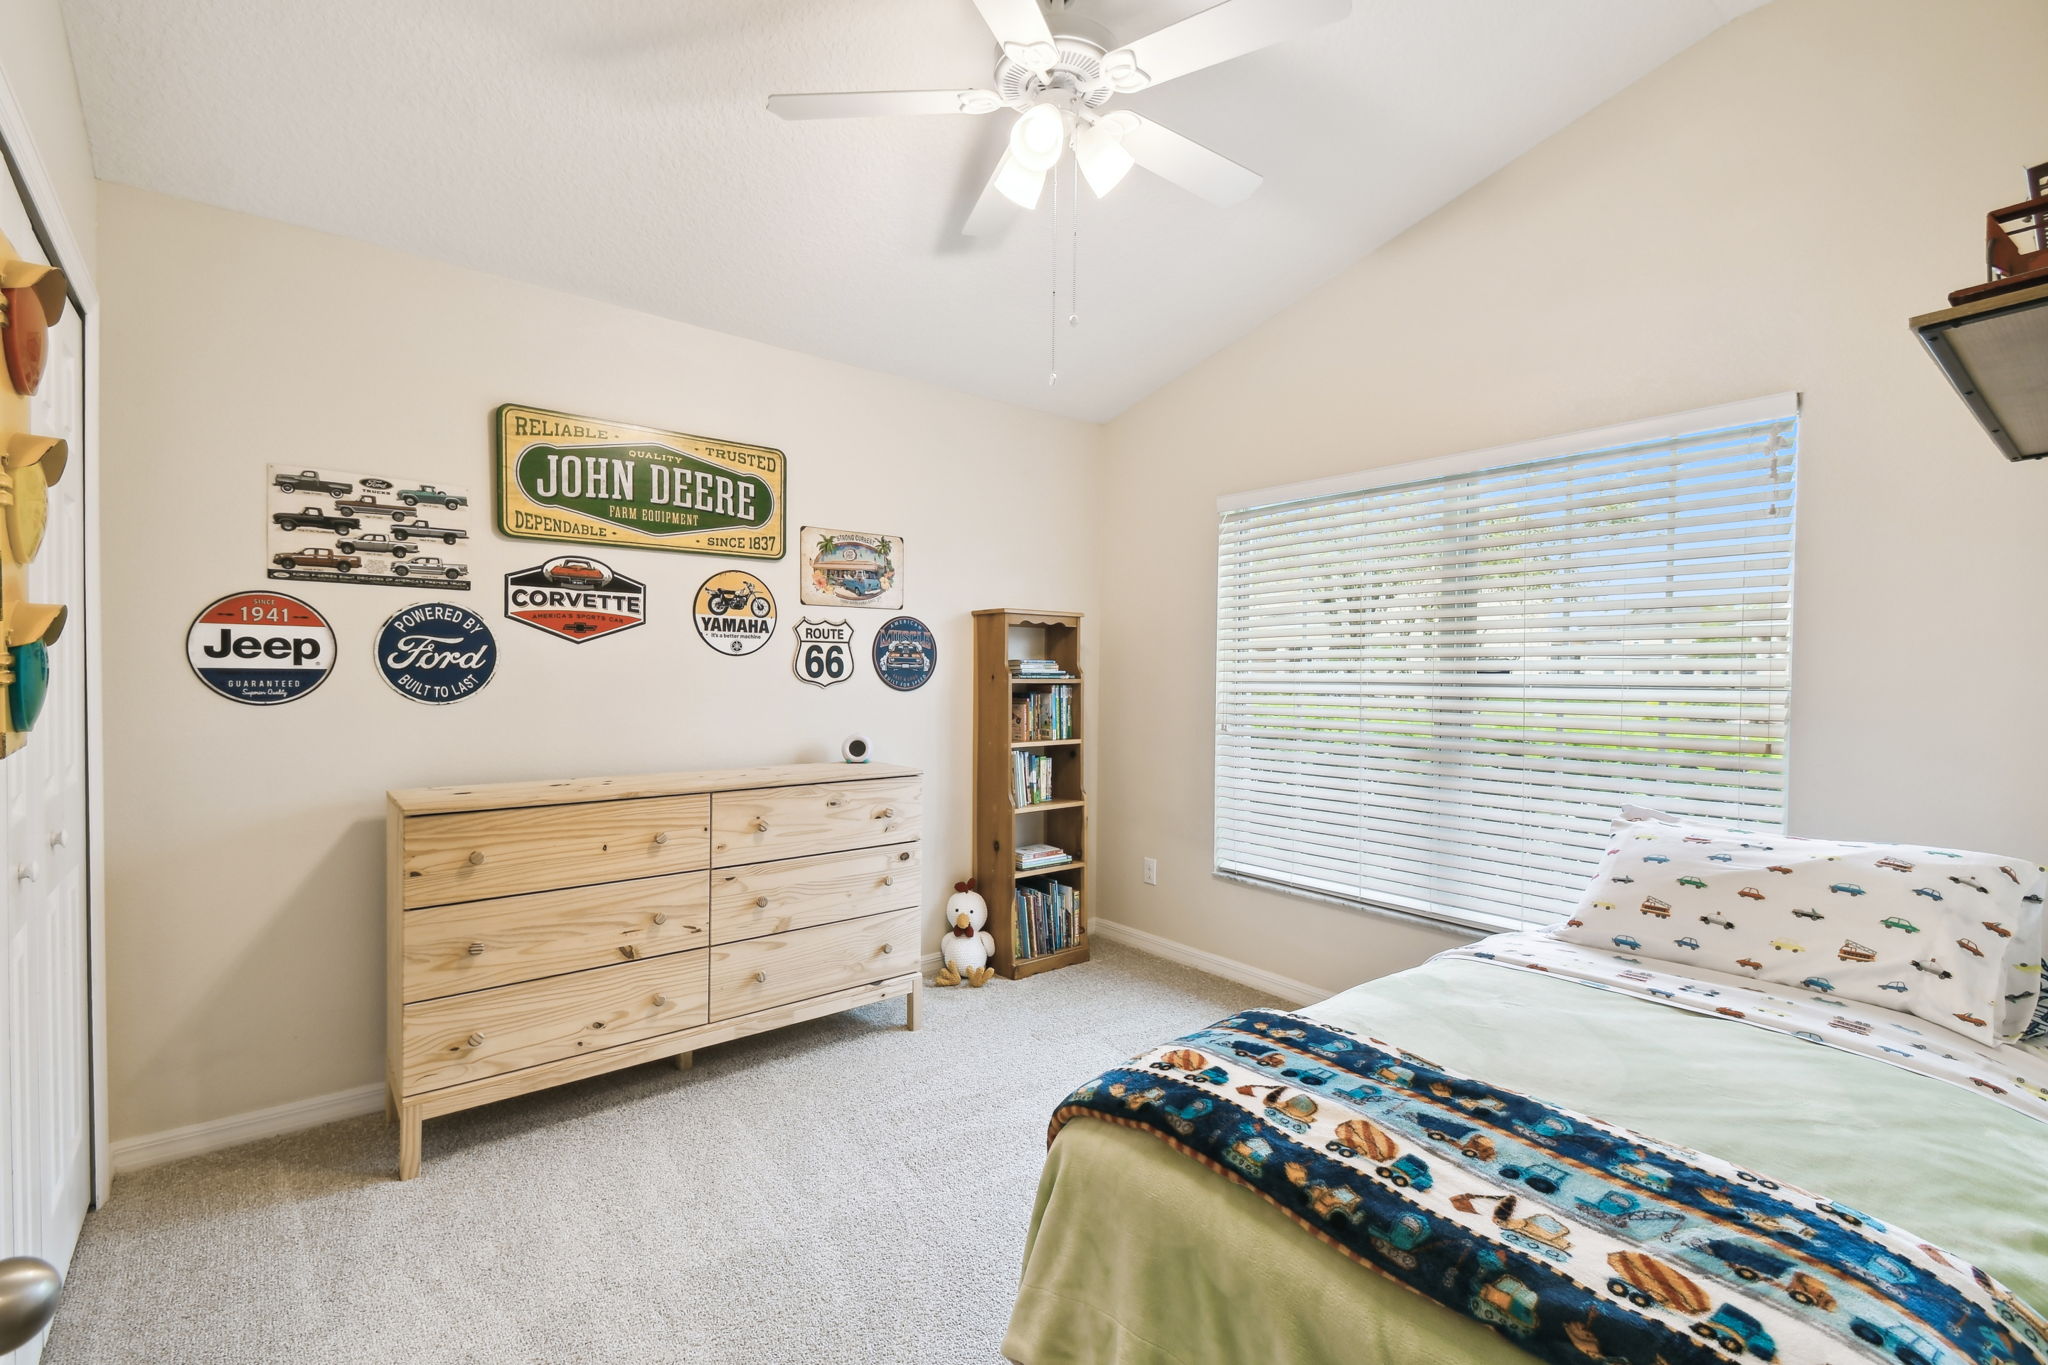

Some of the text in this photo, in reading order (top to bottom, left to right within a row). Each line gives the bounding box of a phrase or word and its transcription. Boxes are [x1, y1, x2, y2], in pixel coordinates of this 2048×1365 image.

[514, 416, 609, 439] RELIABLE
[629, 450, 683, 464] QUALITY
[705, 447, 776, 472] TRUSTED
[536, 455, 755, 521] JOHN DEERE
[514, 510, 607, 537] DEPENDABLE
[609, 505, 699, 526] FARM EQUIPMENT
[707, 536, 776, 551] SINCE 1837
[253, 598, 276, 606] SINCE
[511, 588, 641, 614] CORVETTE
[240, 606, 289, 622] 1941
[393, 606, 484, 634] POWERED BY
[701, 616, 770, 634] YAMAHA
[890, 619, 922, 630] AMERICAN
[805, 627, 845, 640] ROUTE
[203, 628, 321, 666] Jeep
[387, 635, 489, 670] Ford
[805, 644, 845, 679] 66
[227, 680, 301, 688] GUARANTEED
[267, 688, 288, 698] Quality
[397, 673, 479, 698] BUILT TO LAST
